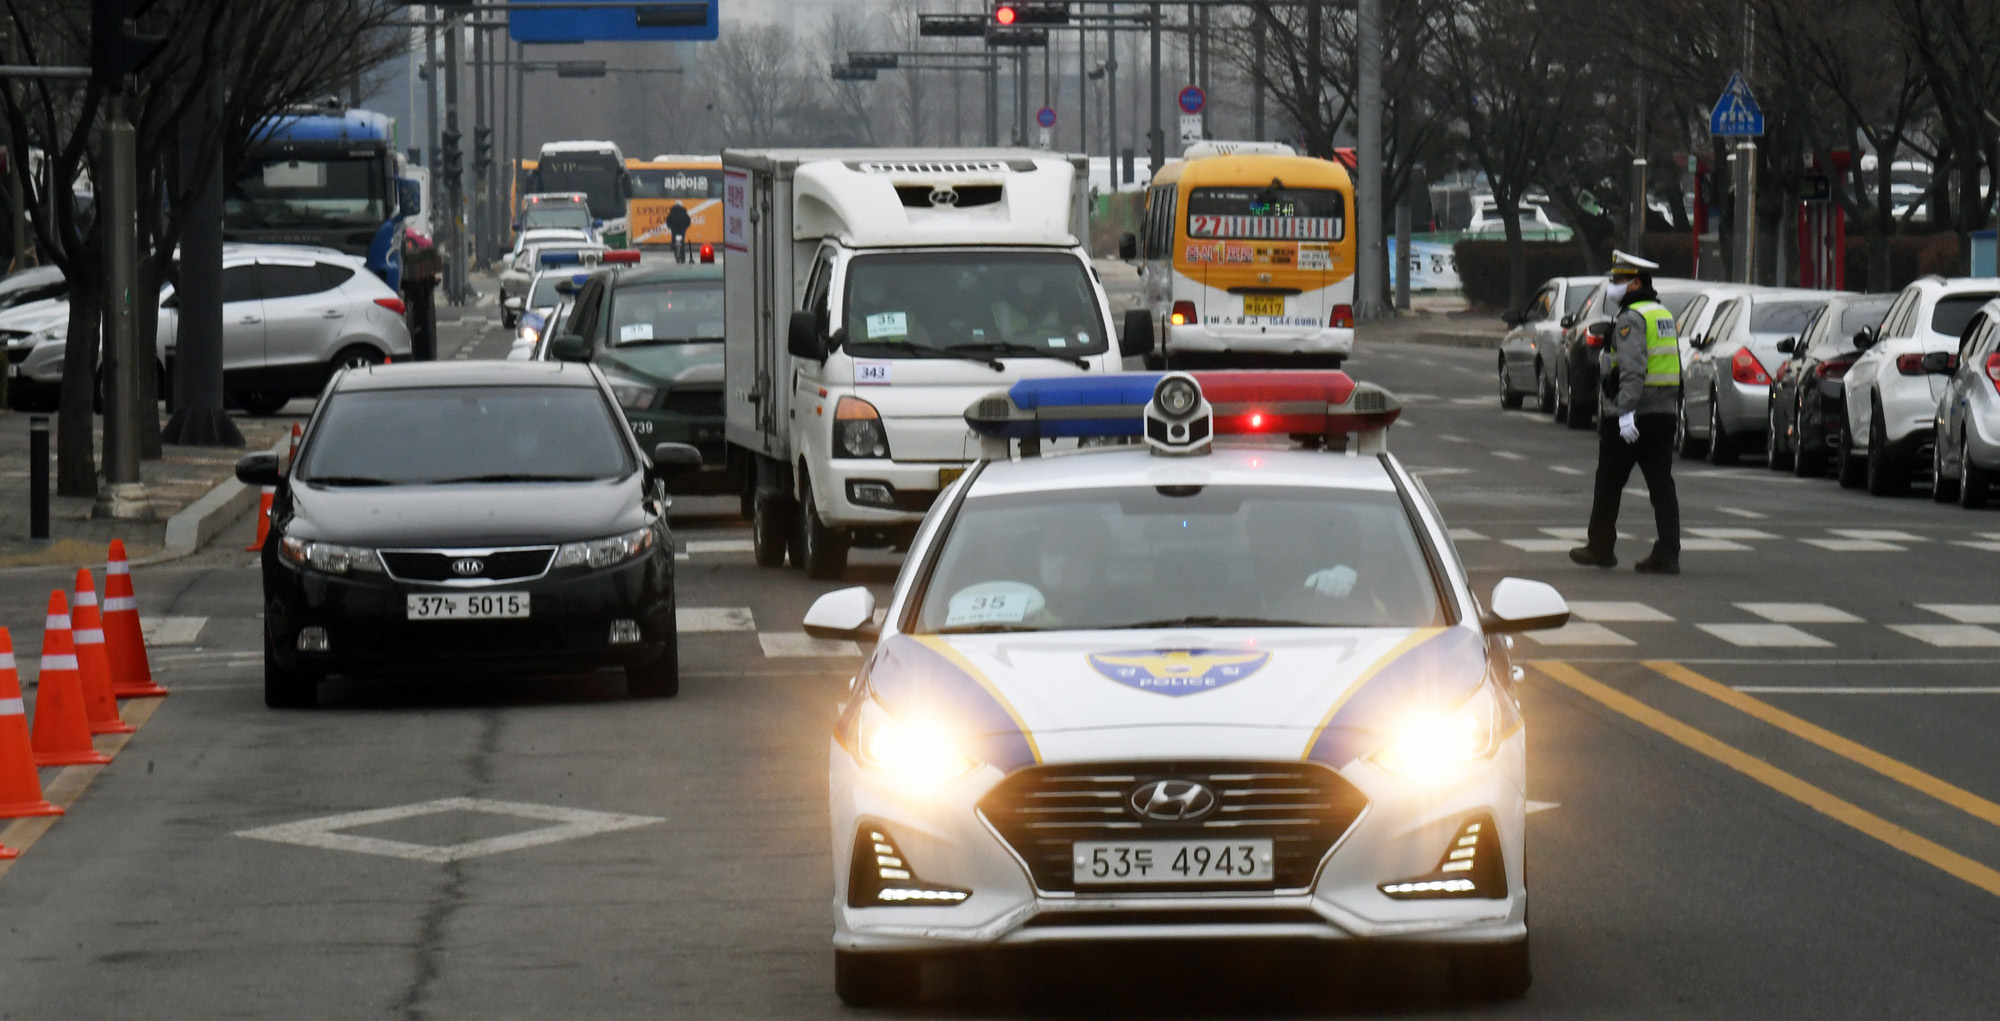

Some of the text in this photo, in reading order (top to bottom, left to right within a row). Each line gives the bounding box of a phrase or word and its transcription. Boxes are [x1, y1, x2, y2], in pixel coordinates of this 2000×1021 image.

[1194, 214, 1222, 236] 27
[878, 312, 895, 325] 35
[861, 366, 885, 379] 343
[458, 560, 479, 572] KIA
[417, 595, 520, 616] 37누 5015
[971, 595, 1007, 611] 35
[1139, 677, 1216, 687] POLICE
[1092, 845, 1256, 877] 53두 4943
